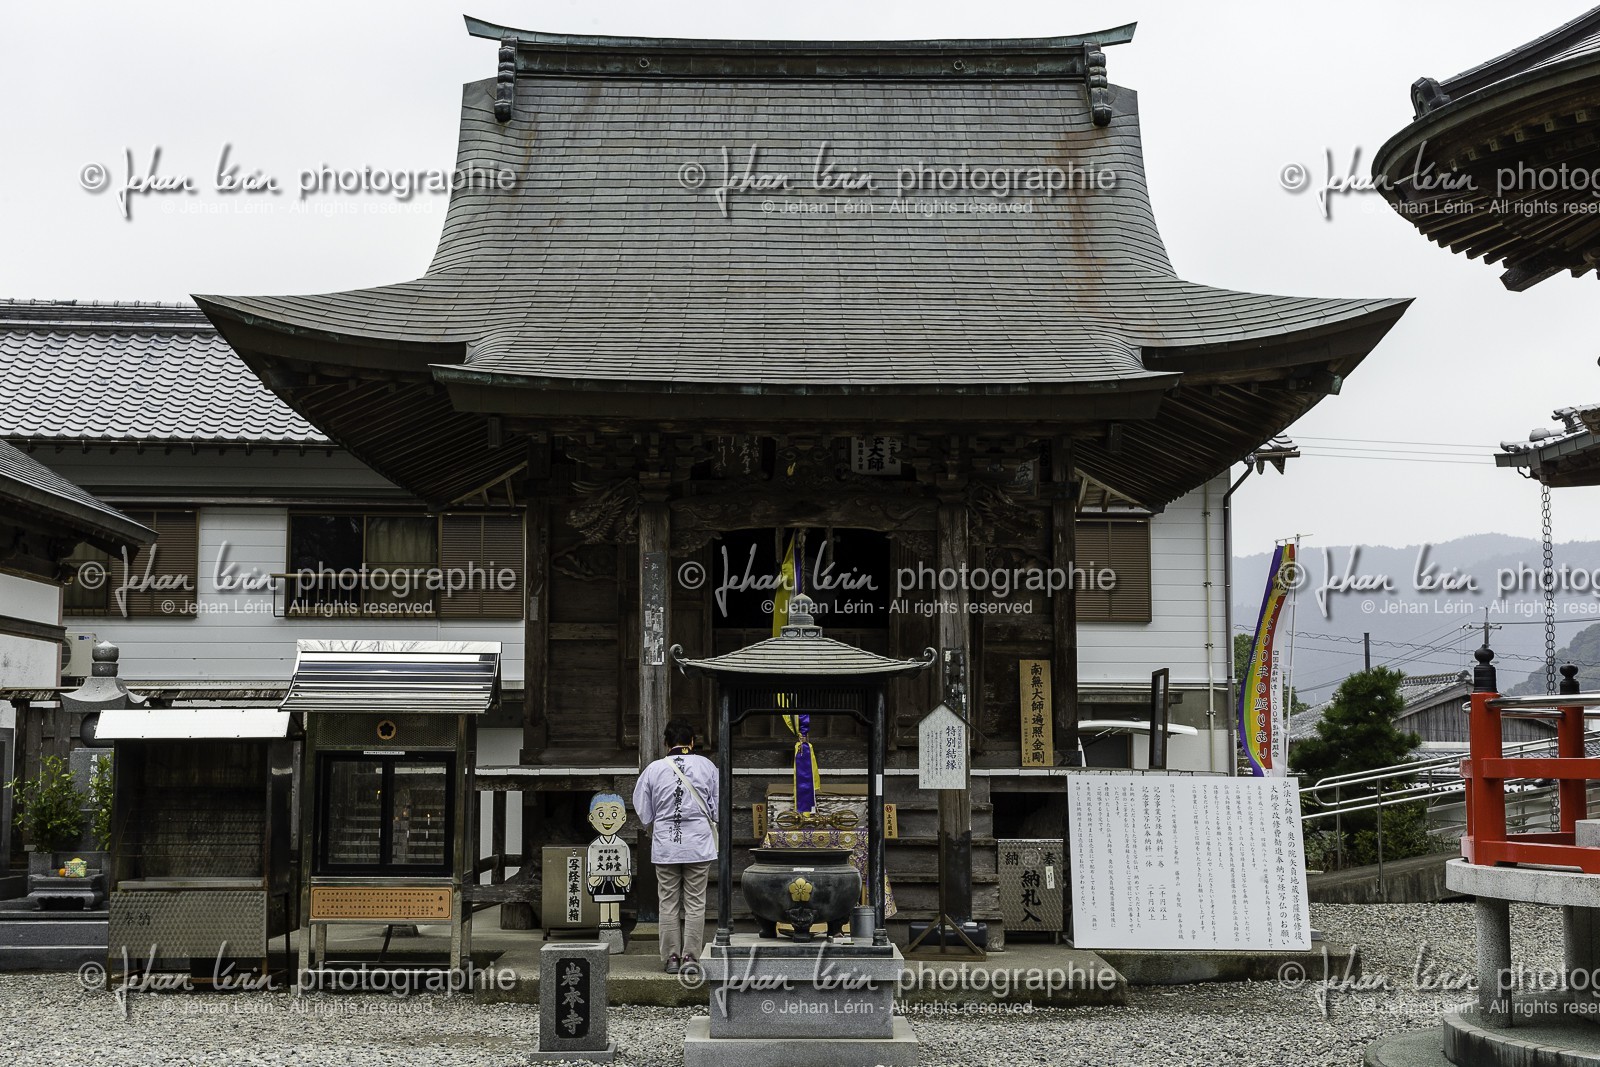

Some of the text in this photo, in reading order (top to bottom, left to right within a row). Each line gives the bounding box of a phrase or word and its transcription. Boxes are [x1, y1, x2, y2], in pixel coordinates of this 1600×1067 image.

[1031, 663, 1045, 764] 南無大師遍照金剛
[945, 725, 957, 770] 特別結縁
[886, 813, 894, 837] 土足厳禁
[595, 862, 622, 872] 大師堂
[568, 858, 580, 921] 写経奉納箱
[1020, 869, 1042, 923] 納札入
[1146, 884, 1156, 921] 二千円以上
[1159, 884, 1168, 921] 二千円以上
[122, 911, 151, 927] 奉納
[560, 961, 585, 1035] 岩本寺
